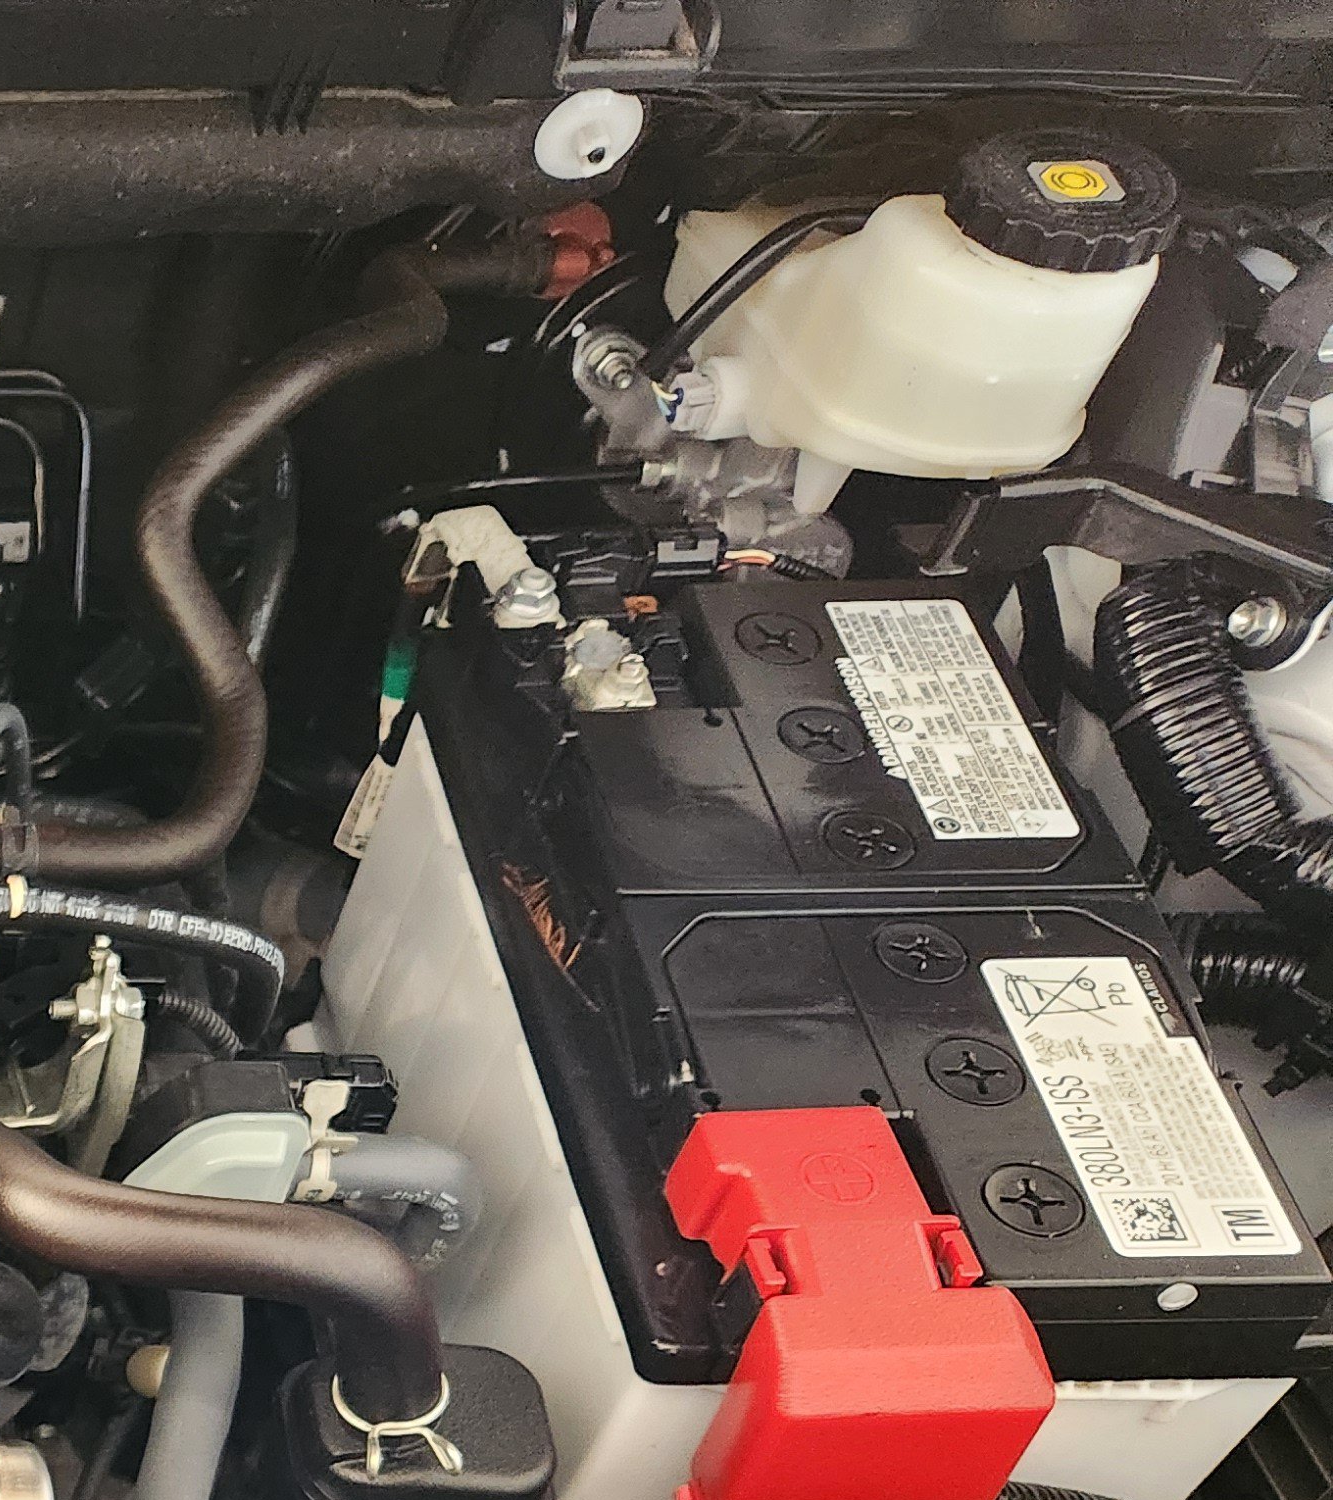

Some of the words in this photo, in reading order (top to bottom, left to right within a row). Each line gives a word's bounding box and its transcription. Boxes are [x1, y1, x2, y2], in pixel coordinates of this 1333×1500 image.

[835, 657, 900, 767] DANGER/POISON
[1101, 982, 1133, 1005] Pb
[1132, 963, 1170, 1012] CLARIOS
[1043, 1074, 1131, 1187] 380LN3-ISS
[1123, 1102, 1154, 1122] CCA
[1220, 1209, 1277, 1240] TM
